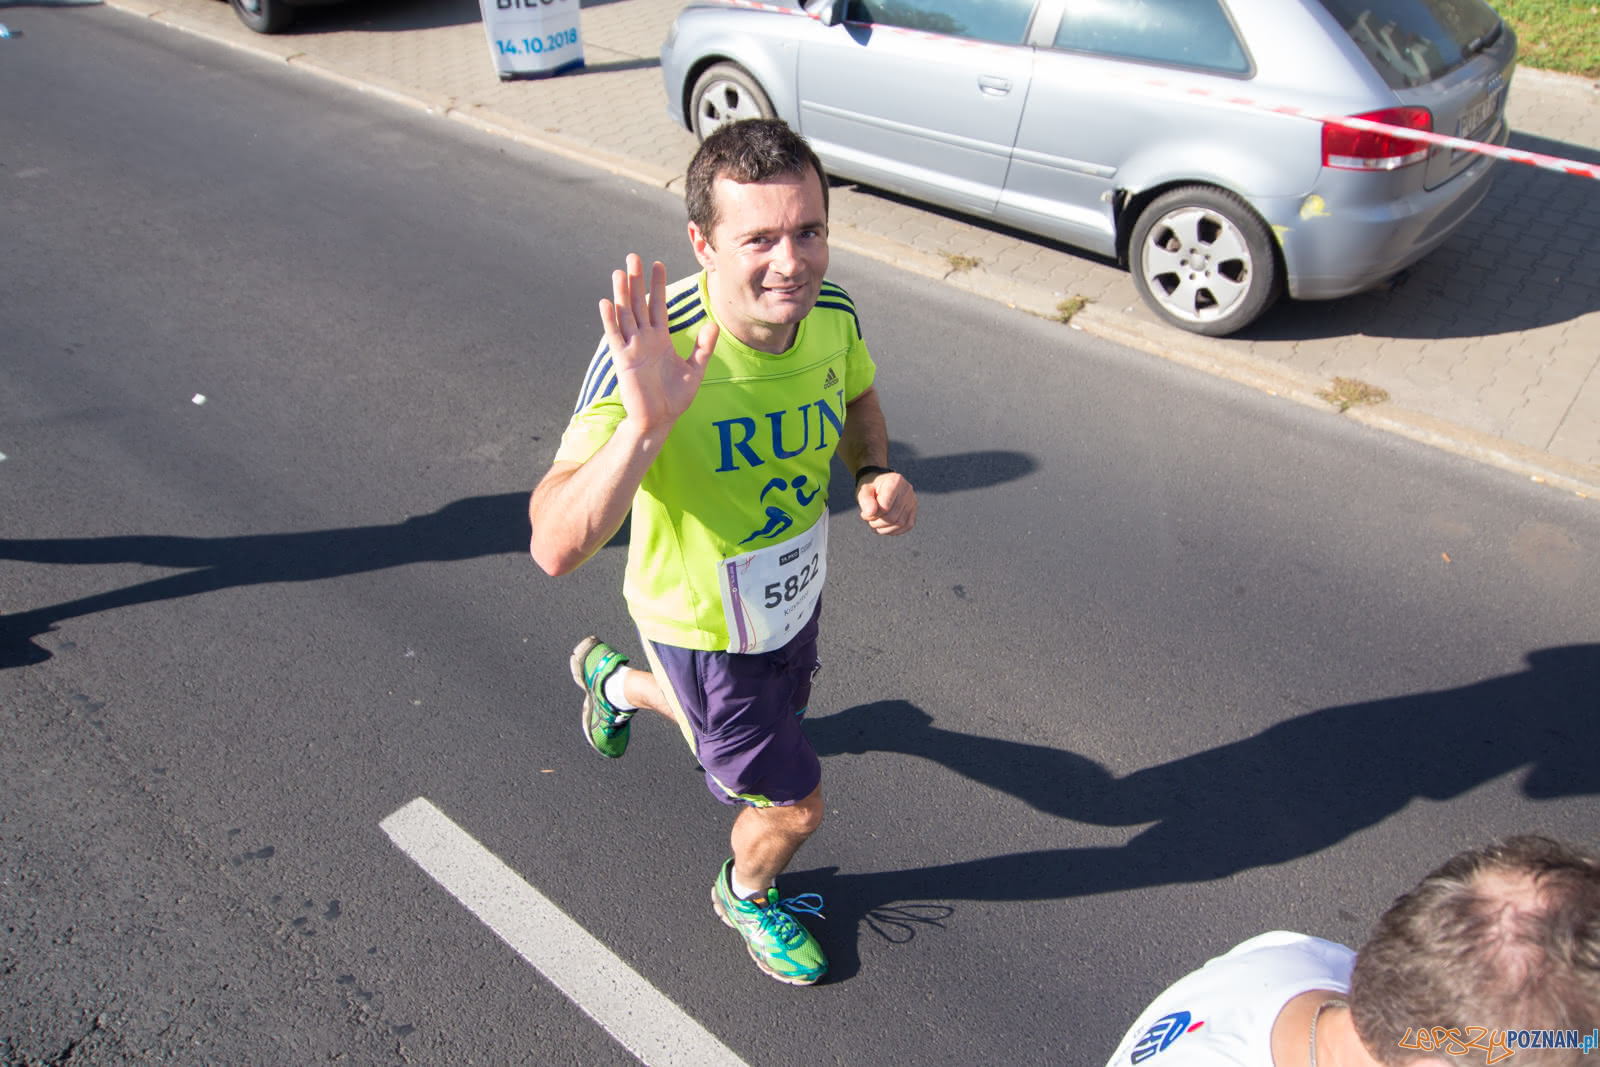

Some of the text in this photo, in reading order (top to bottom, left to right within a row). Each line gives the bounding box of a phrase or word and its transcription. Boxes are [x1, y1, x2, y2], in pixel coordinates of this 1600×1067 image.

[496, 27, 577, 55] 14.10.2018
[711, 388, 844, 473] RUN
[764, 552, 819, 609] 5822
